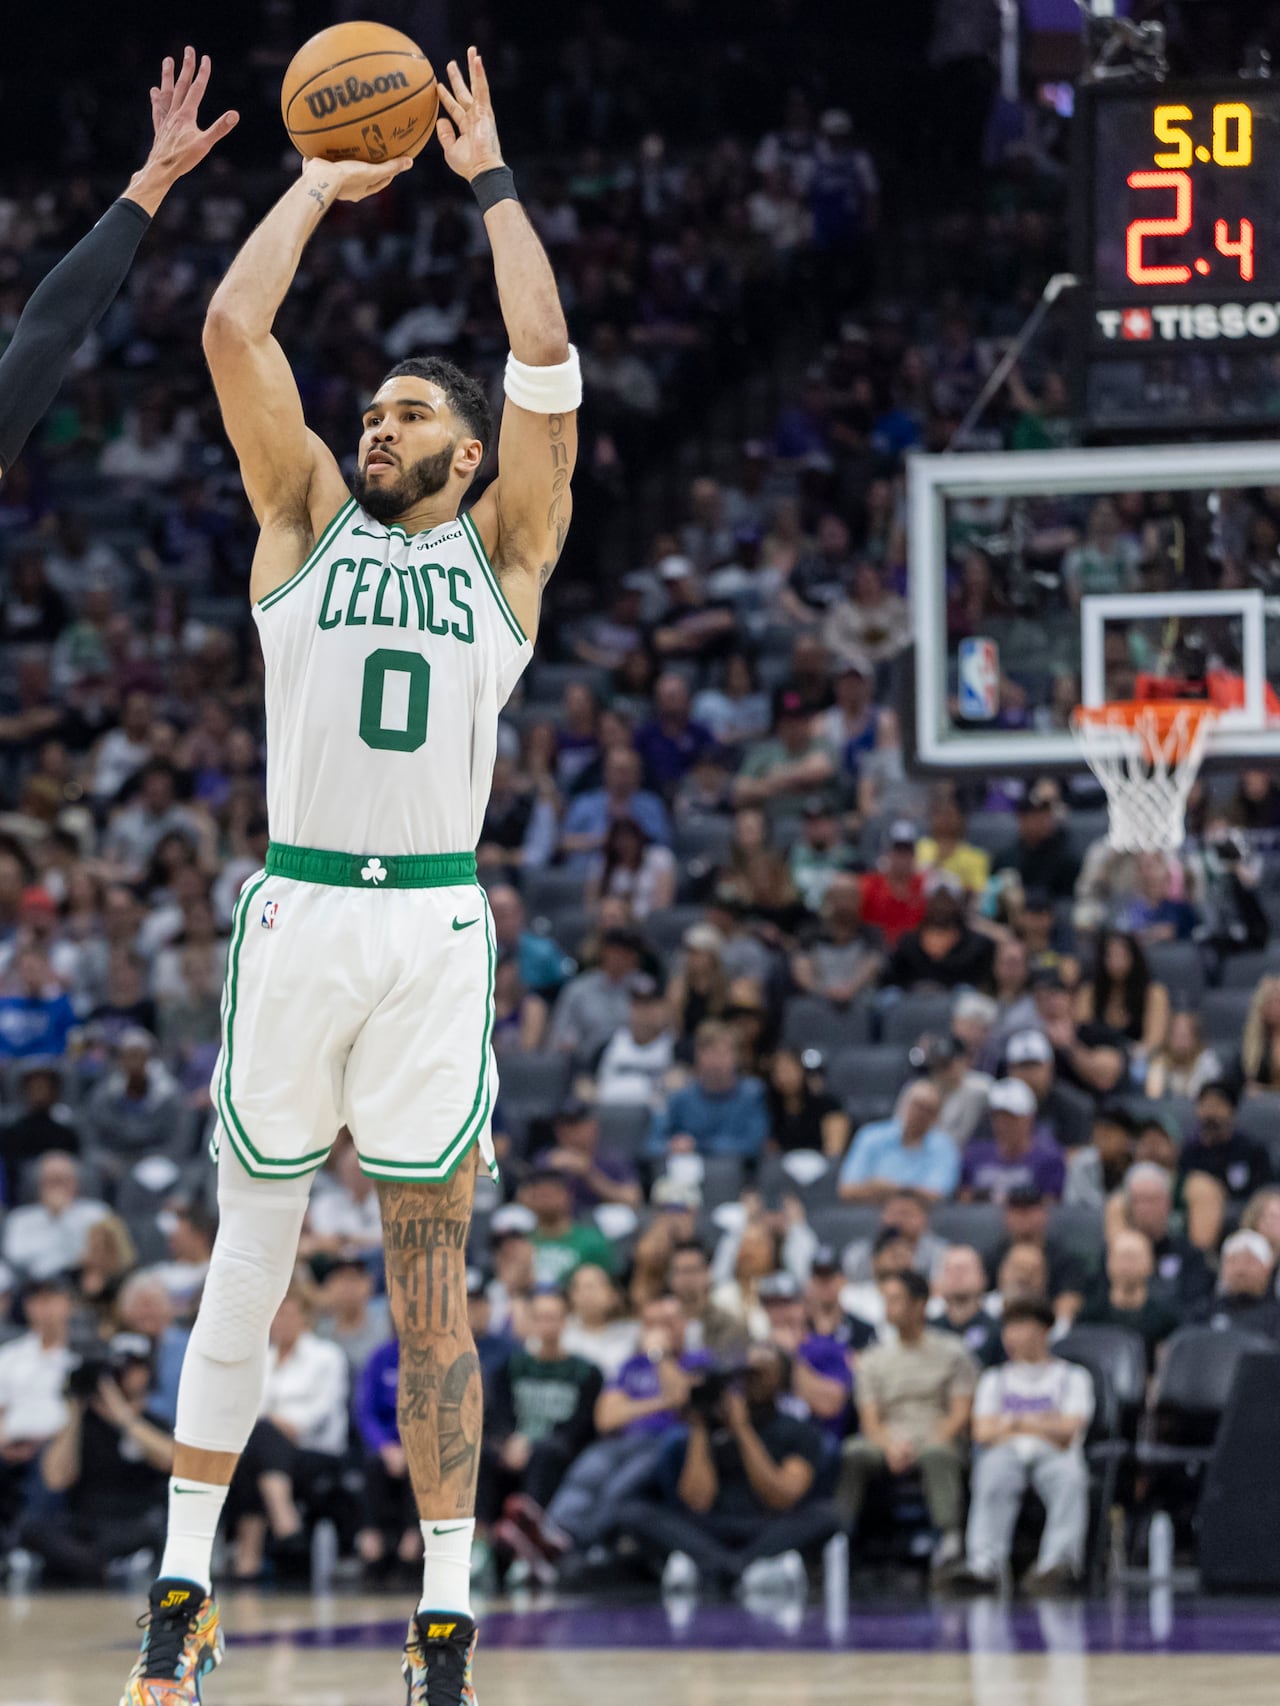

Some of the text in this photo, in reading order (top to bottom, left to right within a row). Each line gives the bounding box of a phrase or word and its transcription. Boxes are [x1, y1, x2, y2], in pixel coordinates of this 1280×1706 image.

[304, 70, 410, 119] Wilson
[1153, 103, 1253, 168] 5.0
[1127, 171, 1254, 285] 2.4
[1152, 302, 1280, 340] TISSO
[417, 530, 462, 550] Amica
[318, 557, 475, 644] CELTICS
[359, 648, 431, 753] 0
